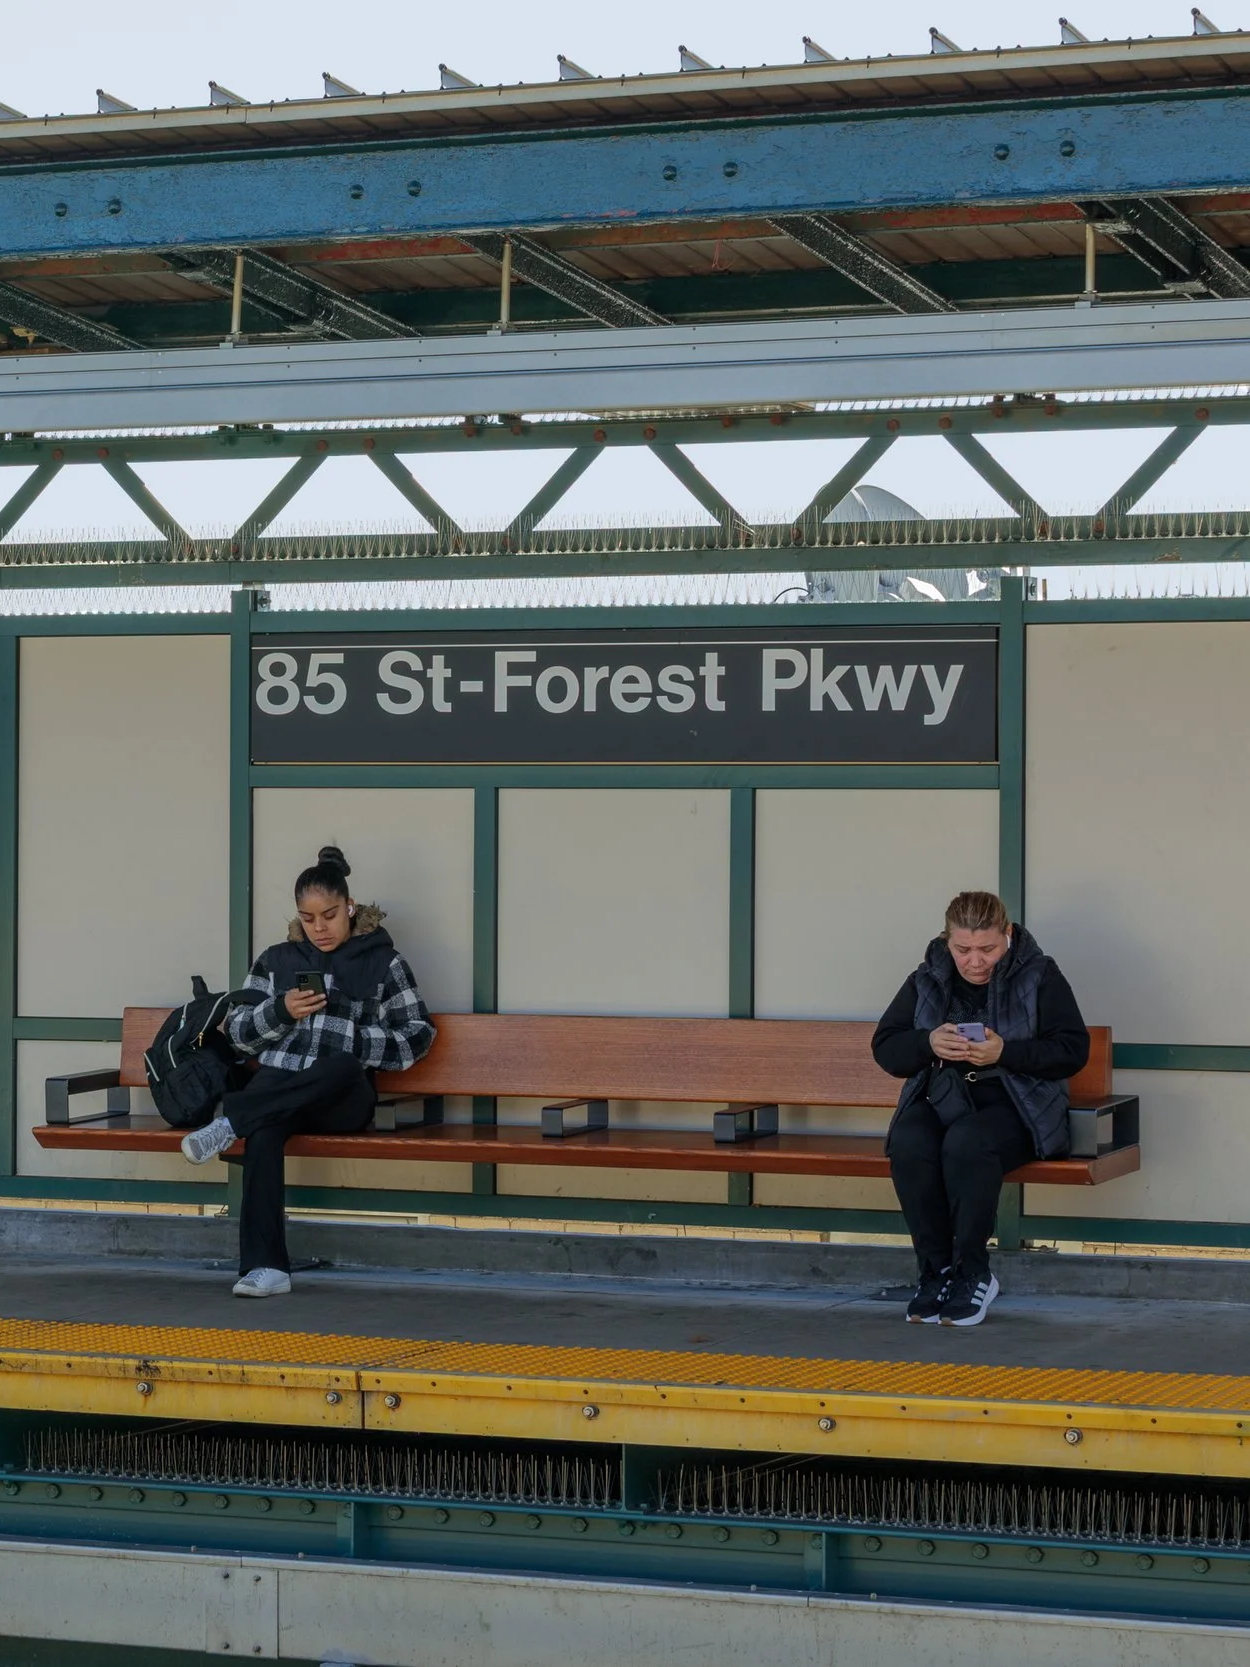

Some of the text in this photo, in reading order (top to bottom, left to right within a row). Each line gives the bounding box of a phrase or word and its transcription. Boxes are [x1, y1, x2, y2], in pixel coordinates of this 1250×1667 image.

[255, 648, 964, 725] 85 St-Forest Pkwy
